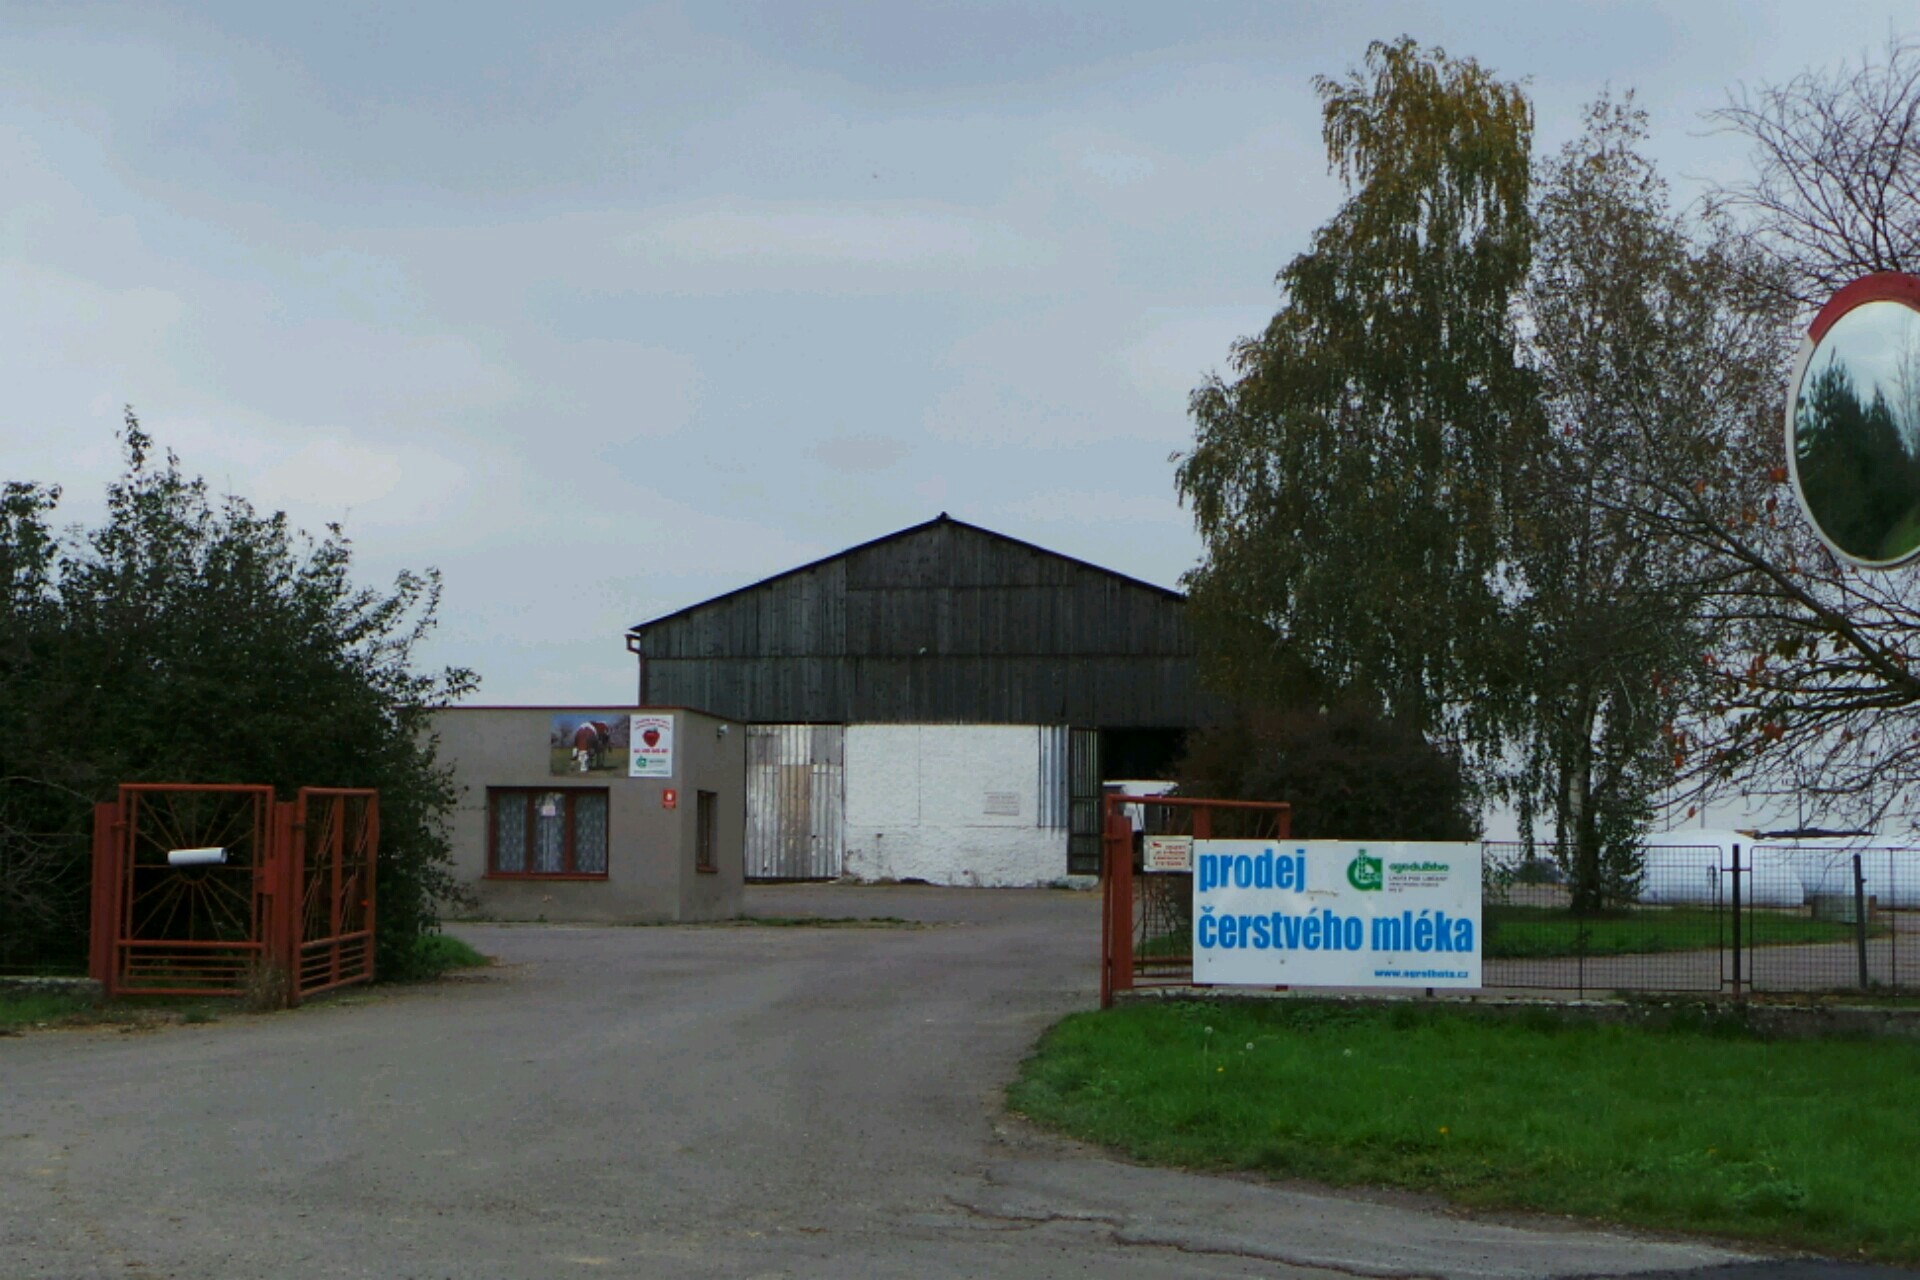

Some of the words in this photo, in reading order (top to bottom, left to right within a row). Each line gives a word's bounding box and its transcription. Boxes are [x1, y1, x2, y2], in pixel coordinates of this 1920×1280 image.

[1199, 849, 1306, 892] prodej
[1198, 906, 1363, 951] čerstvého
[1371, 909, 1474, 953] mléka
[1374, 968, 1469, 979] www.agrolhota.cz
